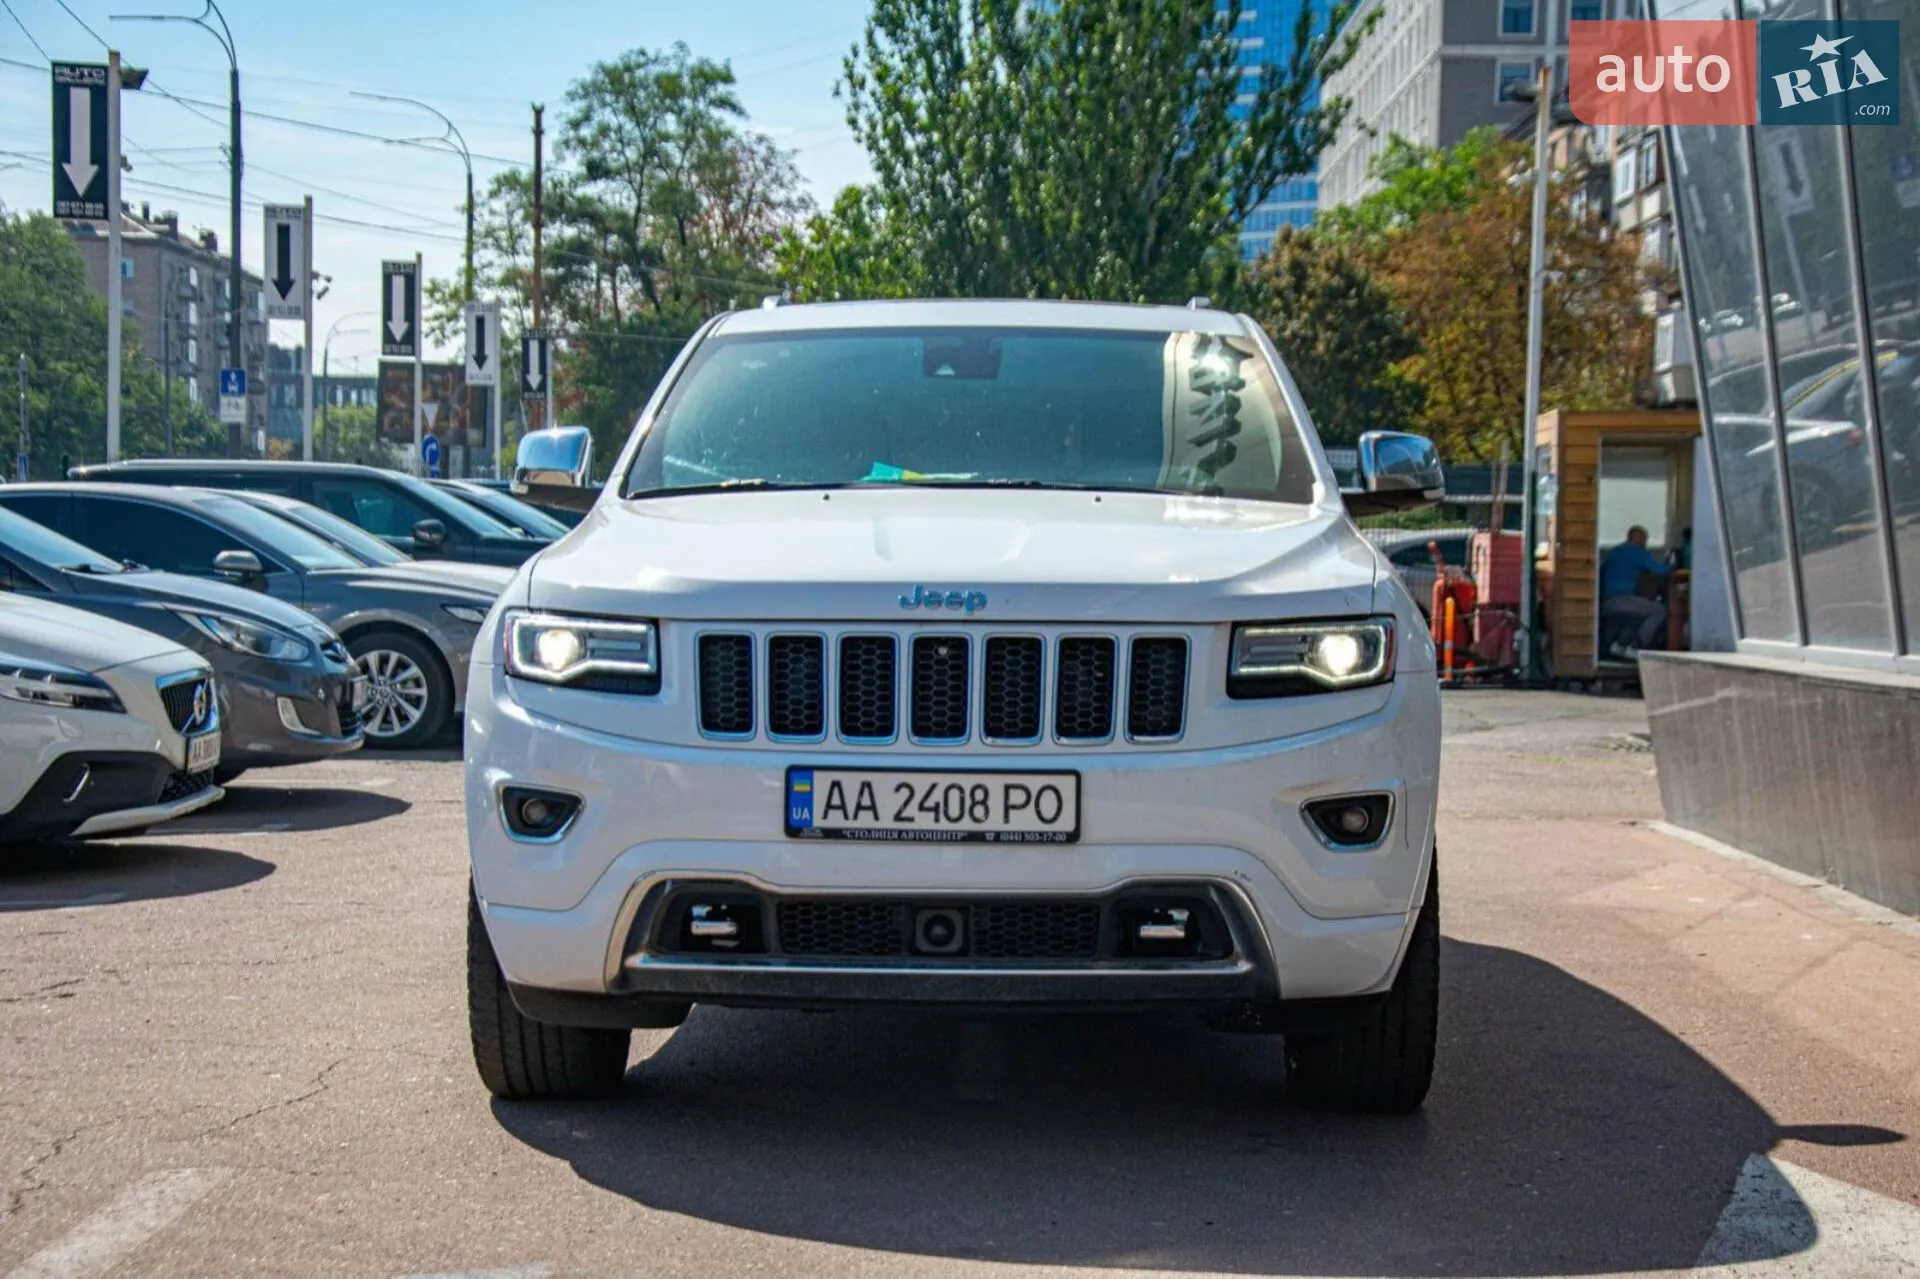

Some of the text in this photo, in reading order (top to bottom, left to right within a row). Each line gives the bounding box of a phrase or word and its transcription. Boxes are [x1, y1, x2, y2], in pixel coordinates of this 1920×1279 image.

[897, 584, 988, 615] Jeep
[792, 806, 810, 820] UA
[822, 780, 1063, 825] AA 2408 PO
